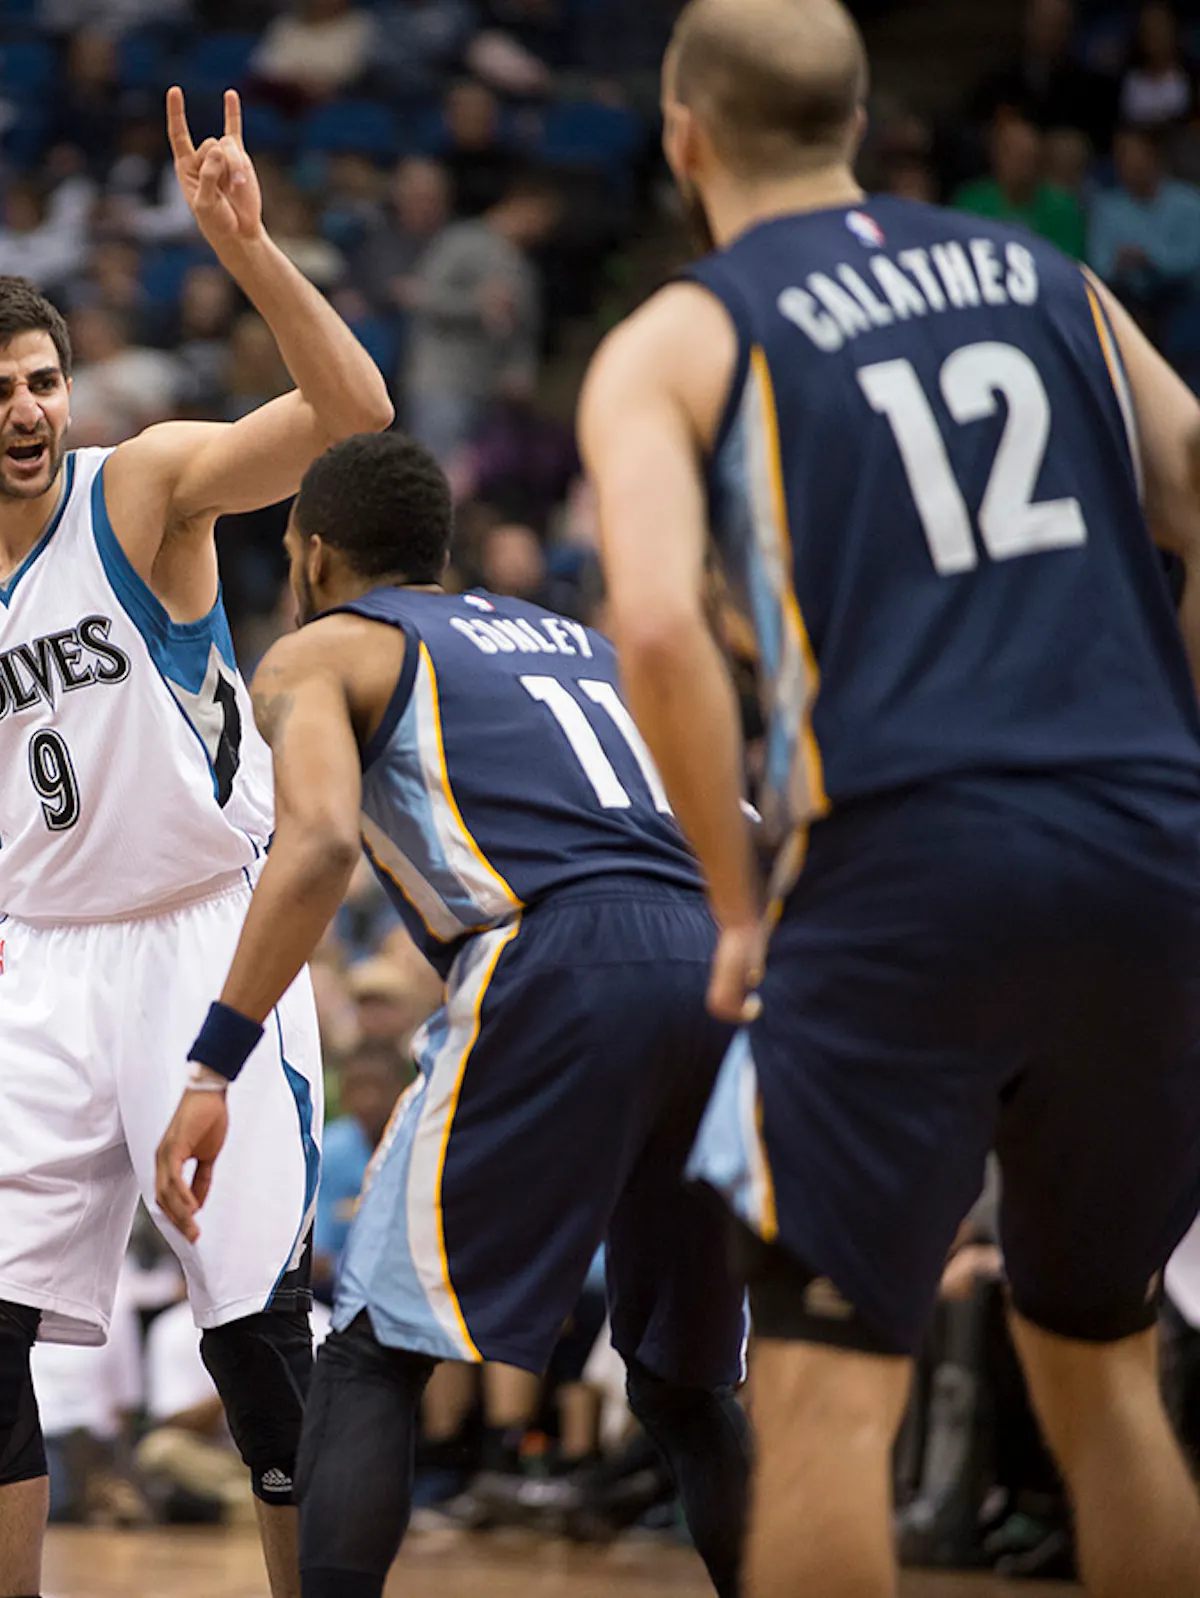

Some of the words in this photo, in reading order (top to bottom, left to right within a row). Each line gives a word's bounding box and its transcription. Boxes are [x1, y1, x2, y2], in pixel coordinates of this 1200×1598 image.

[776, 238, 1039, 353] CALATHES
[856, 341, 1088, 577] 12
[28, 728, 80, 831] 9
[519, 674, 674, 817] 11
